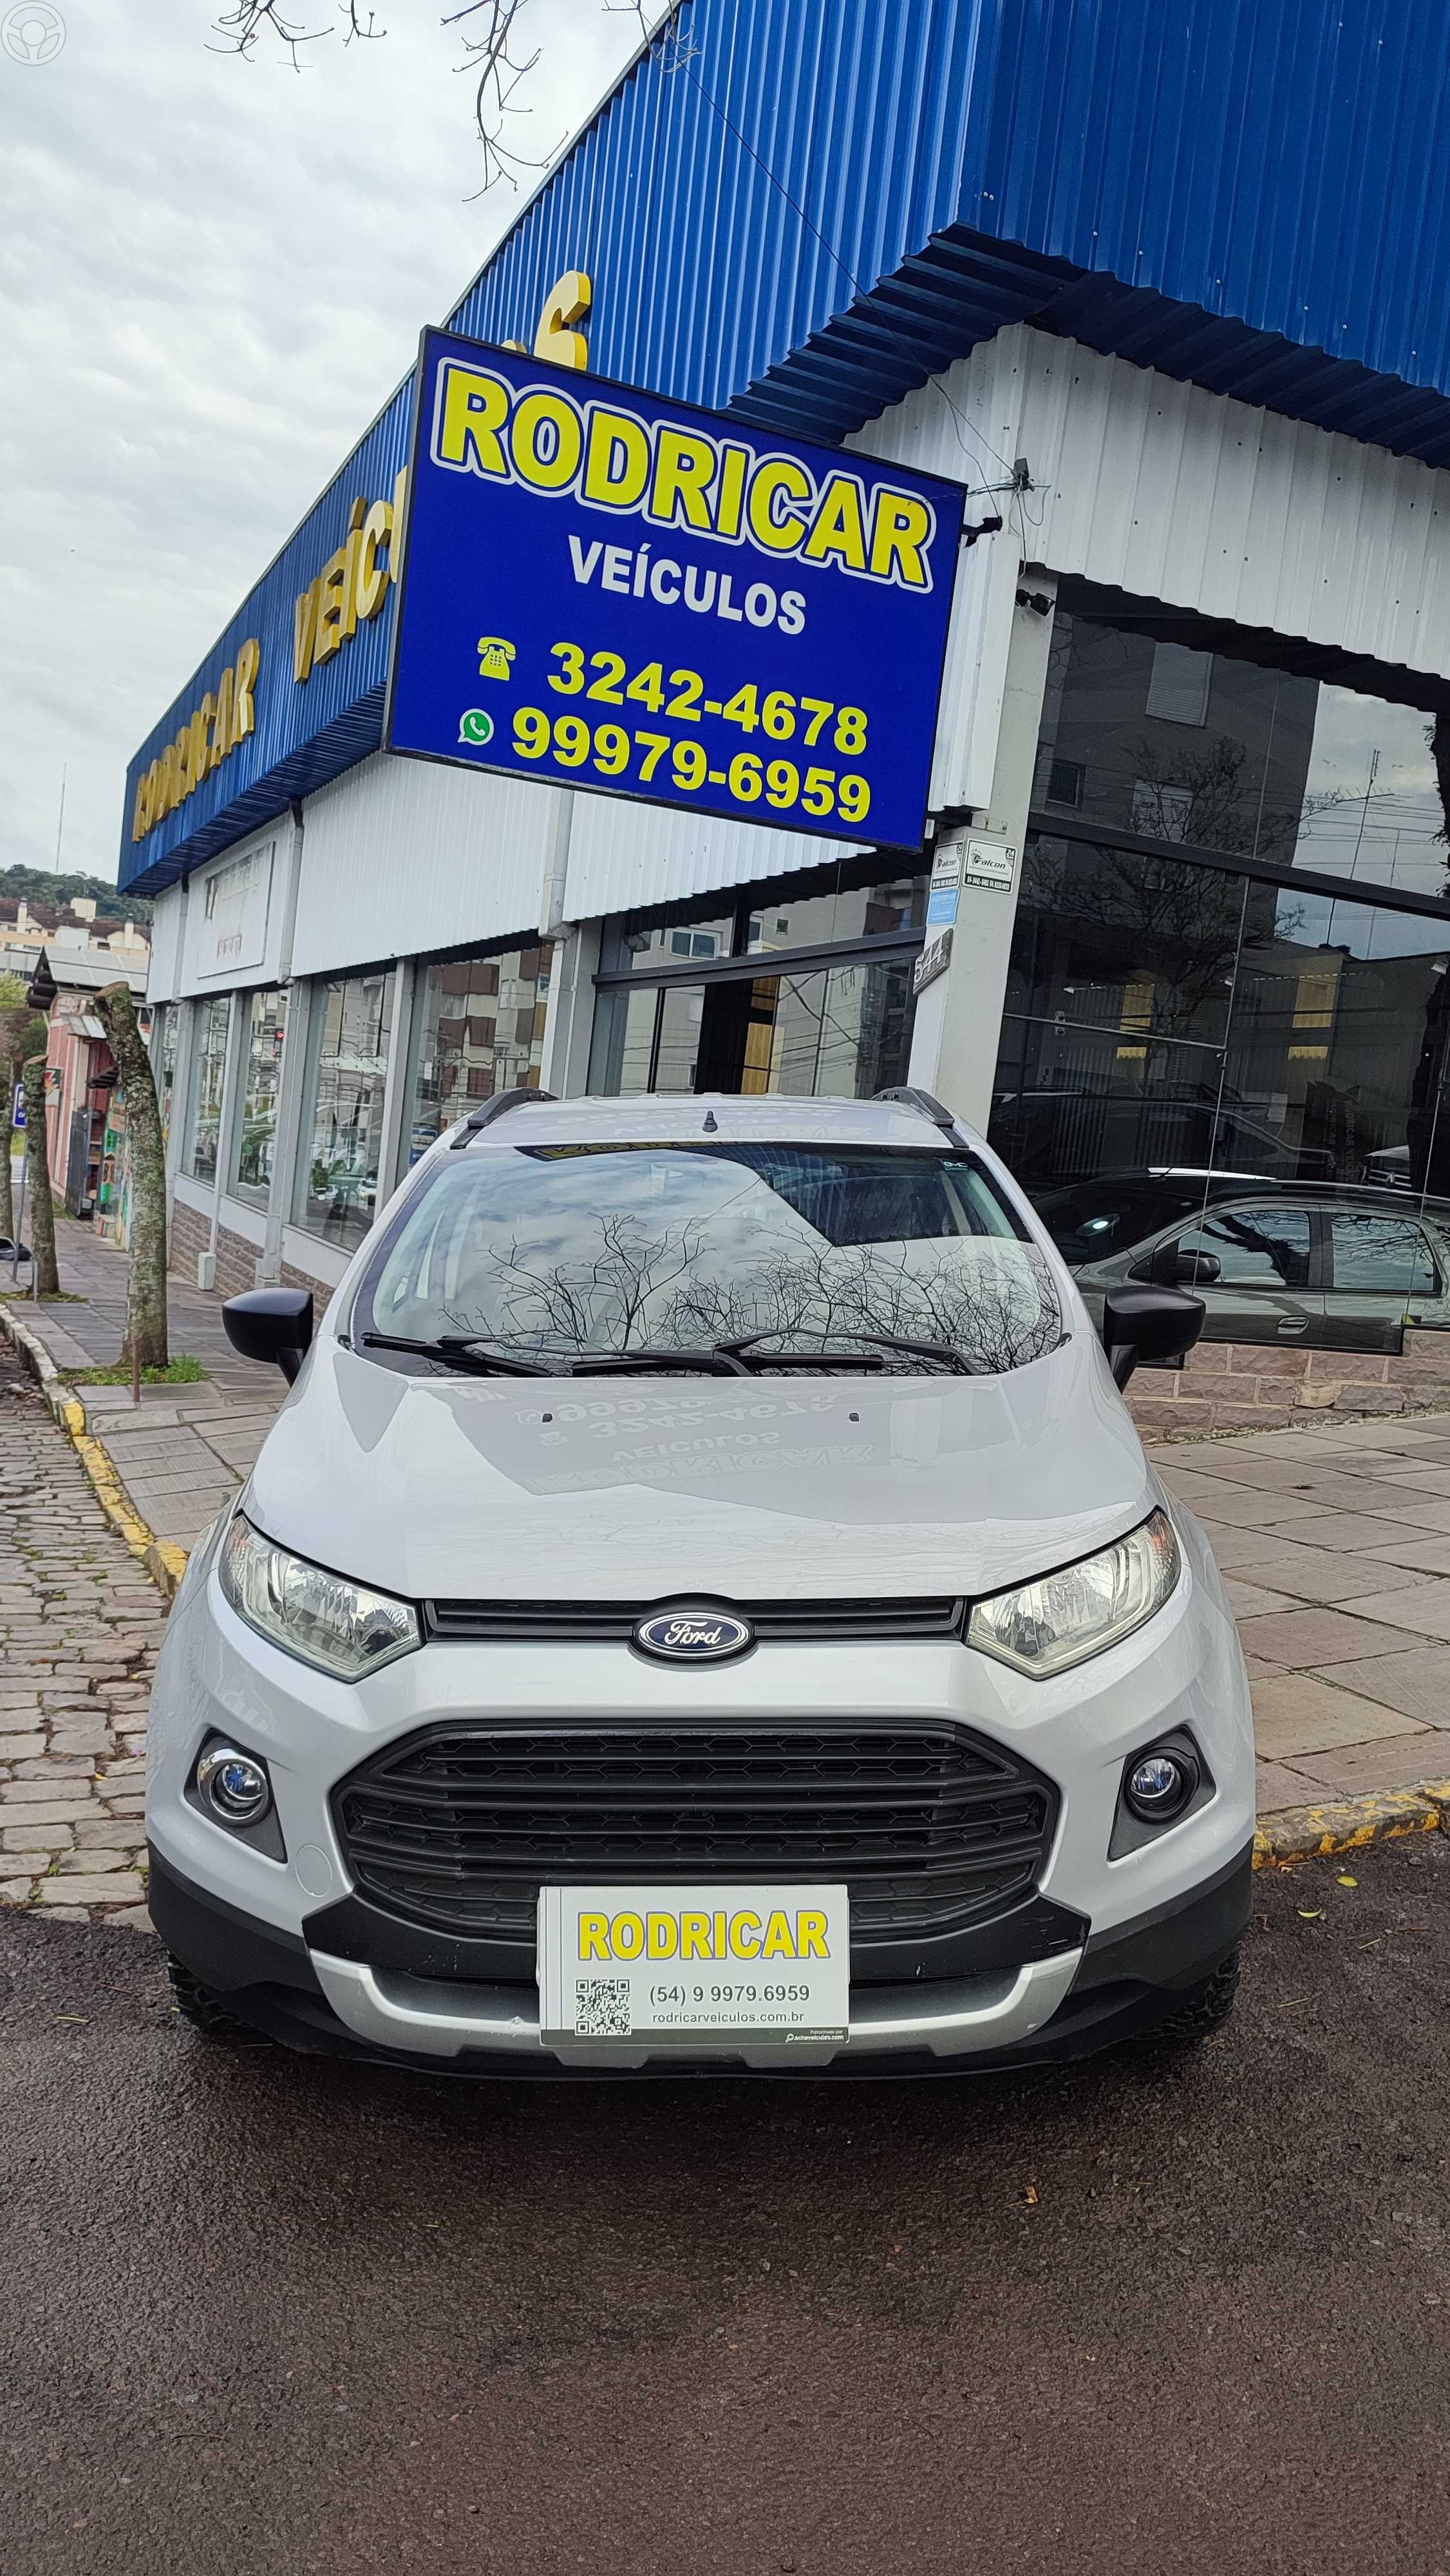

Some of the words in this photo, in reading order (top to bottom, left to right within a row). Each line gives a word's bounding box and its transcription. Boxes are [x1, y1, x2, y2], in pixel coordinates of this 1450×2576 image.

[430, 357, 935, 593] RODRICAR
[568, 535, 806, 635] VEÍCULOS
[547, 641, 868, 756] 3242-4678
[133, 638, 259, 843] RODRICAR
[511, 706, 871, 824] 99979-6959
[972, 855, 1006, 869] Falcon
[914, 934, 944, 984] 544
[664, 1620, 723, 1645] Ford
[578, 1909, 831, 1961] RODRICAR
[650, 1985, 686, 2006] (54)
[693, 1985, 704, 2002] 9
[710, 1985, 810, 2002] 9979.6959
[652, 2011, 805, 2023] rodricarveiculos.com.br
